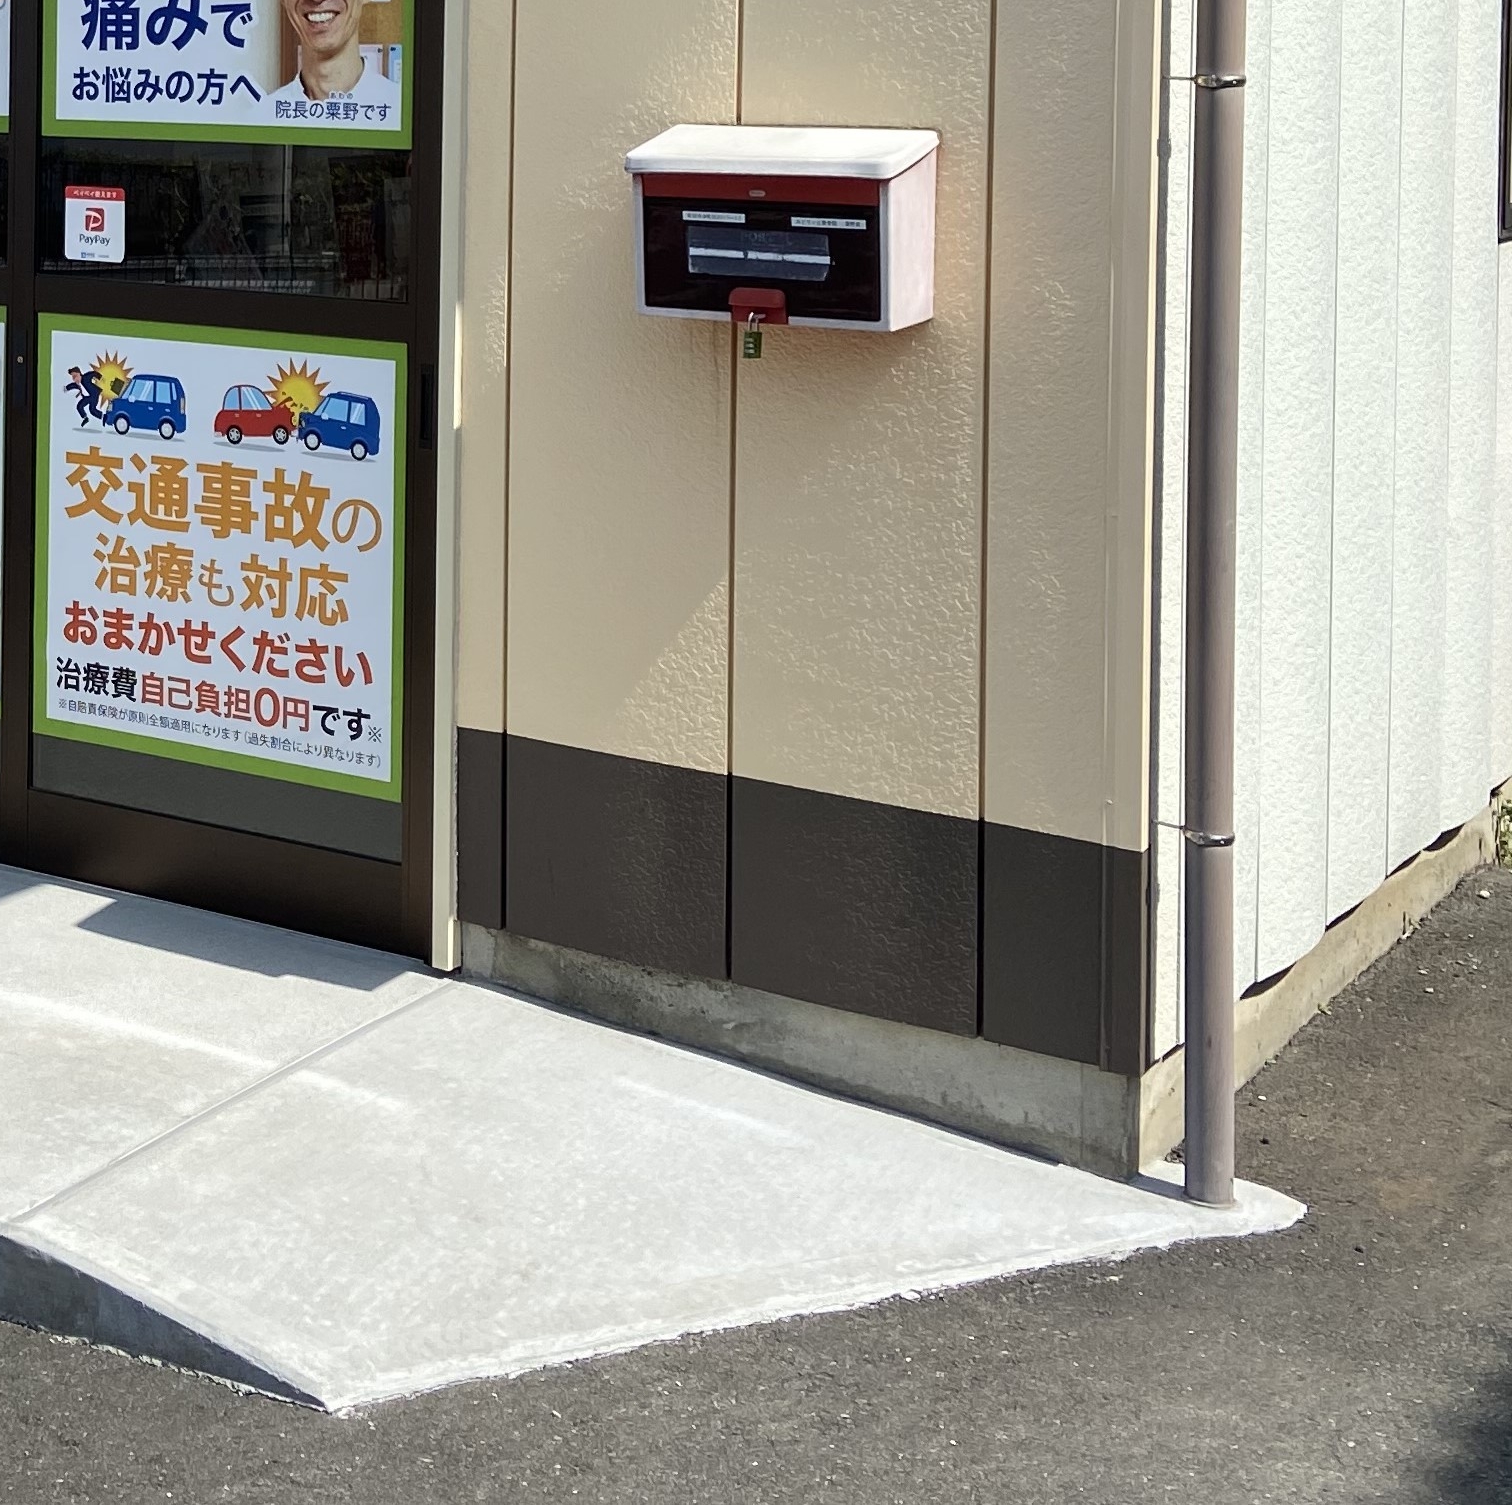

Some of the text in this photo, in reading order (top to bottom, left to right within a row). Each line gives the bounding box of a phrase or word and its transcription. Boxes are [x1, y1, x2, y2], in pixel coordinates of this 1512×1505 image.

[71, 66, 262, 104] お悩みの方へ
[79, 234, 111, 246] PayPay
[64, 446, 383, 552] 交通事故の
[93, 532, 349, 627] 治療も対応
[63, 600, 374, 687] おまかせください
